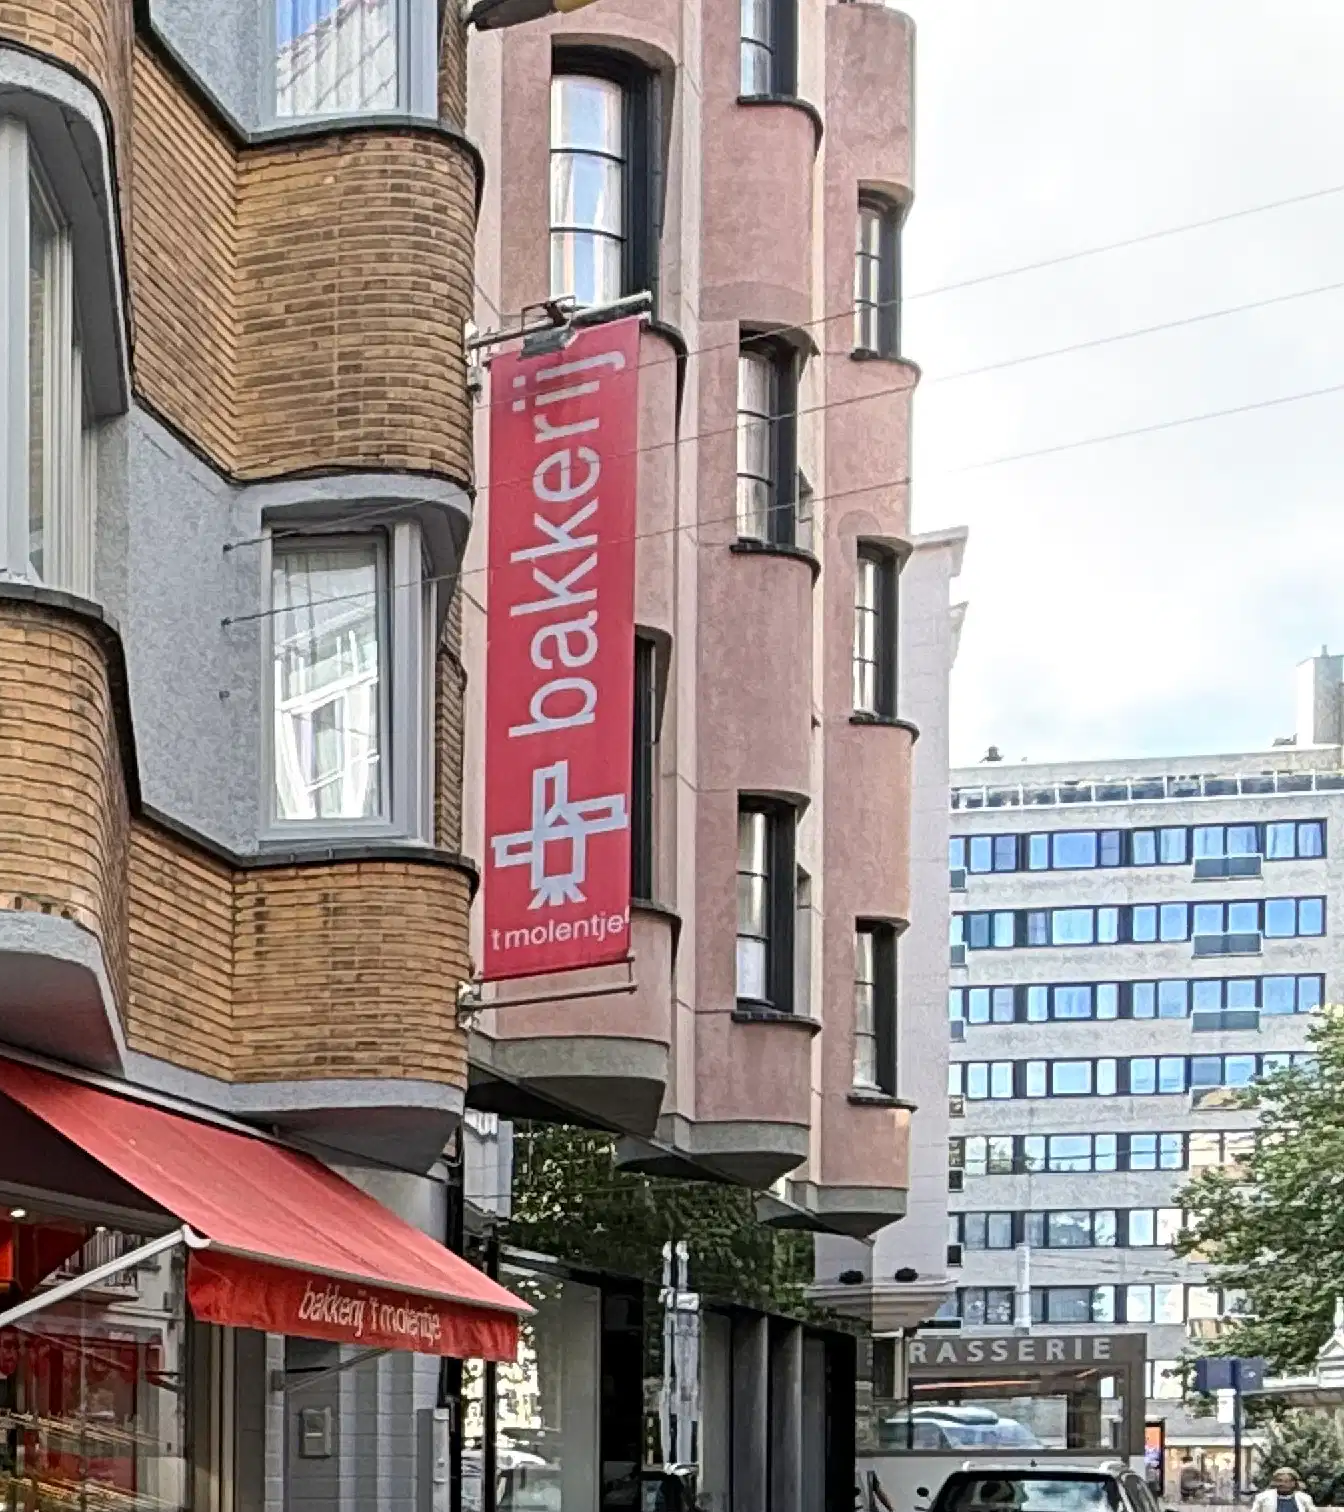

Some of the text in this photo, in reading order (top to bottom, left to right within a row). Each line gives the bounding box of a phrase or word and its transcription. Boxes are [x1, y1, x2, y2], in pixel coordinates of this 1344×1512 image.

[509, 350, 626, 738] bakkerij
[504, 911, 624, 950] molentje
[298, 1280, 367, 1338] bakkerij
[380, 1299, 442, 1347] molentje
[909, 1337, 1111, 1363] RASSERIE
